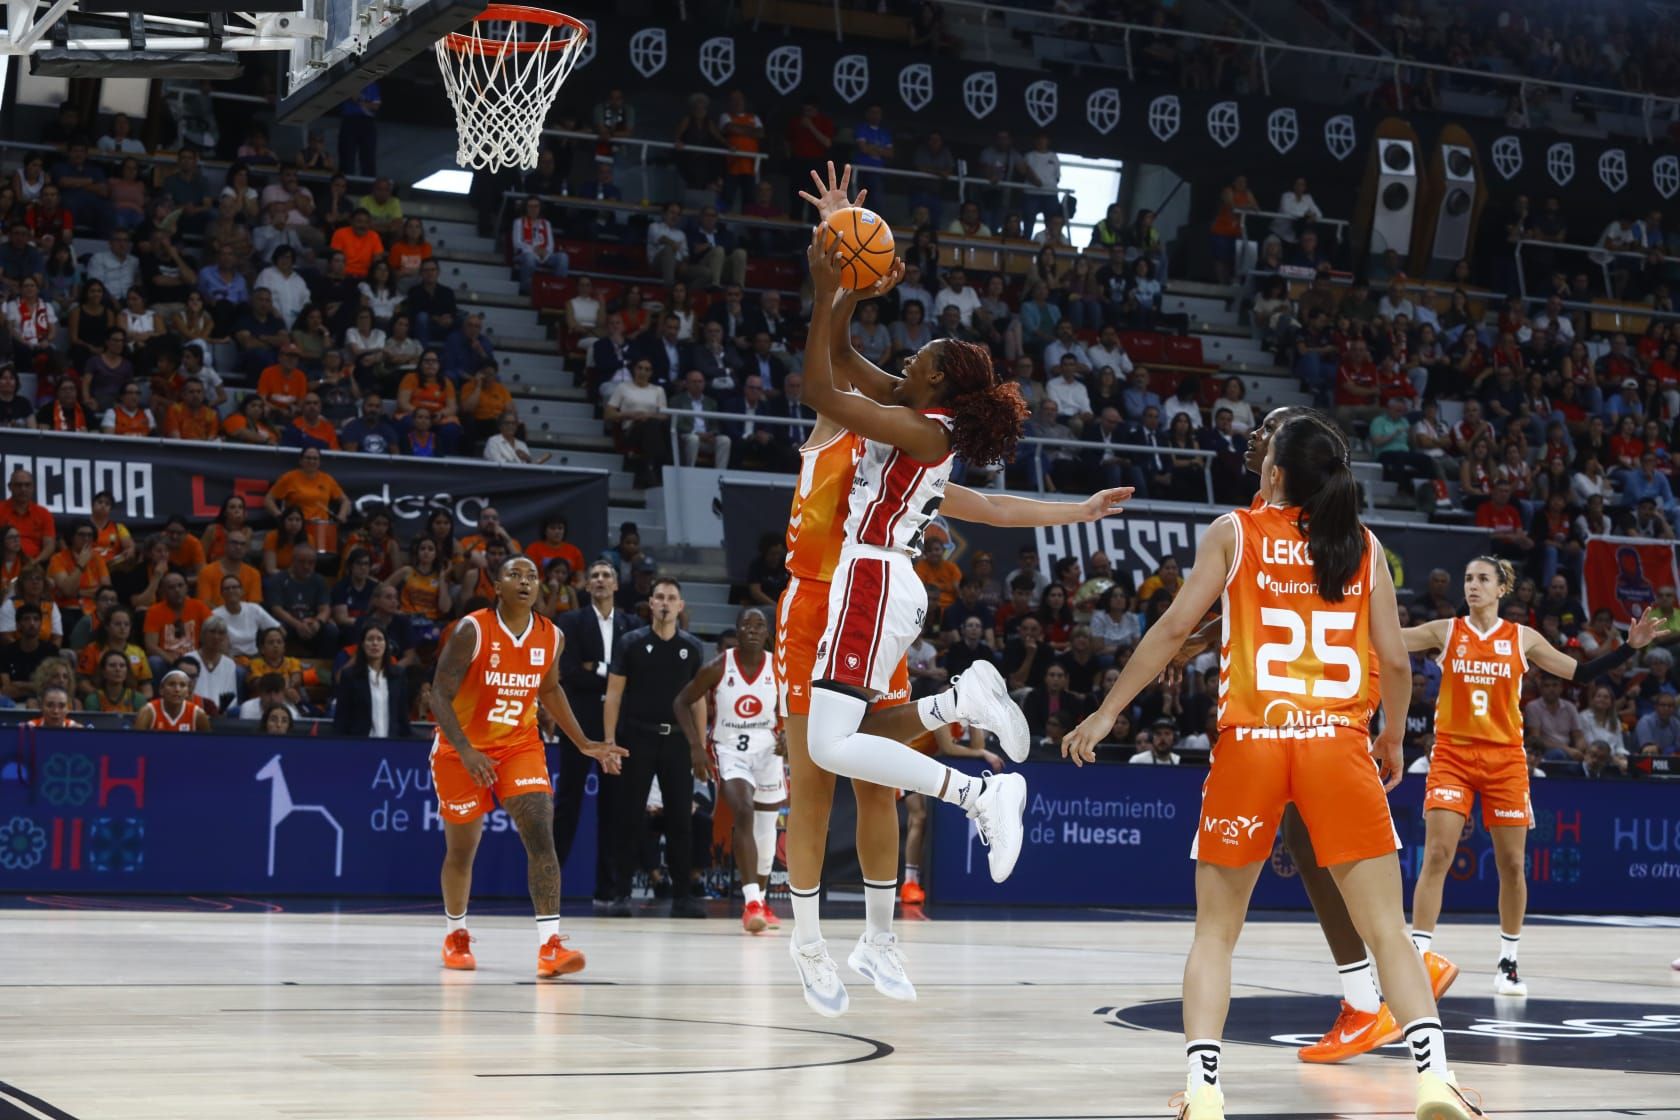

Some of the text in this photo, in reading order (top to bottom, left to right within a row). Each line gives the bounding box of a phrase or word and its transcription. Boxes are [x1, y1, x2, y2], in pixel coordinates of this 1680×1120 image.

[1034, 518, 1212, 592] HUESC
[1256, 606, 1362, 700] 25
[485, 670, 541, 688] VALENCIA
[1451, 658, 1512, 679] VALENCIA
[1463, 674, 1497, 686] BASKET
[497, 687, 529, 697] BASKET
[1471, 689, 1489, 717] 9
[486, 698, 523, 727] 22
[736, 734, 750, 752] 3
[370, 804, 409, 832] de
[1030, 793, 1176, 821] Ayuntamiento
[1030, 821, 1142, 846] de Huesca
[1204, 816, 1239, 838] MGS
[1628, 862, 1648, 878] es
